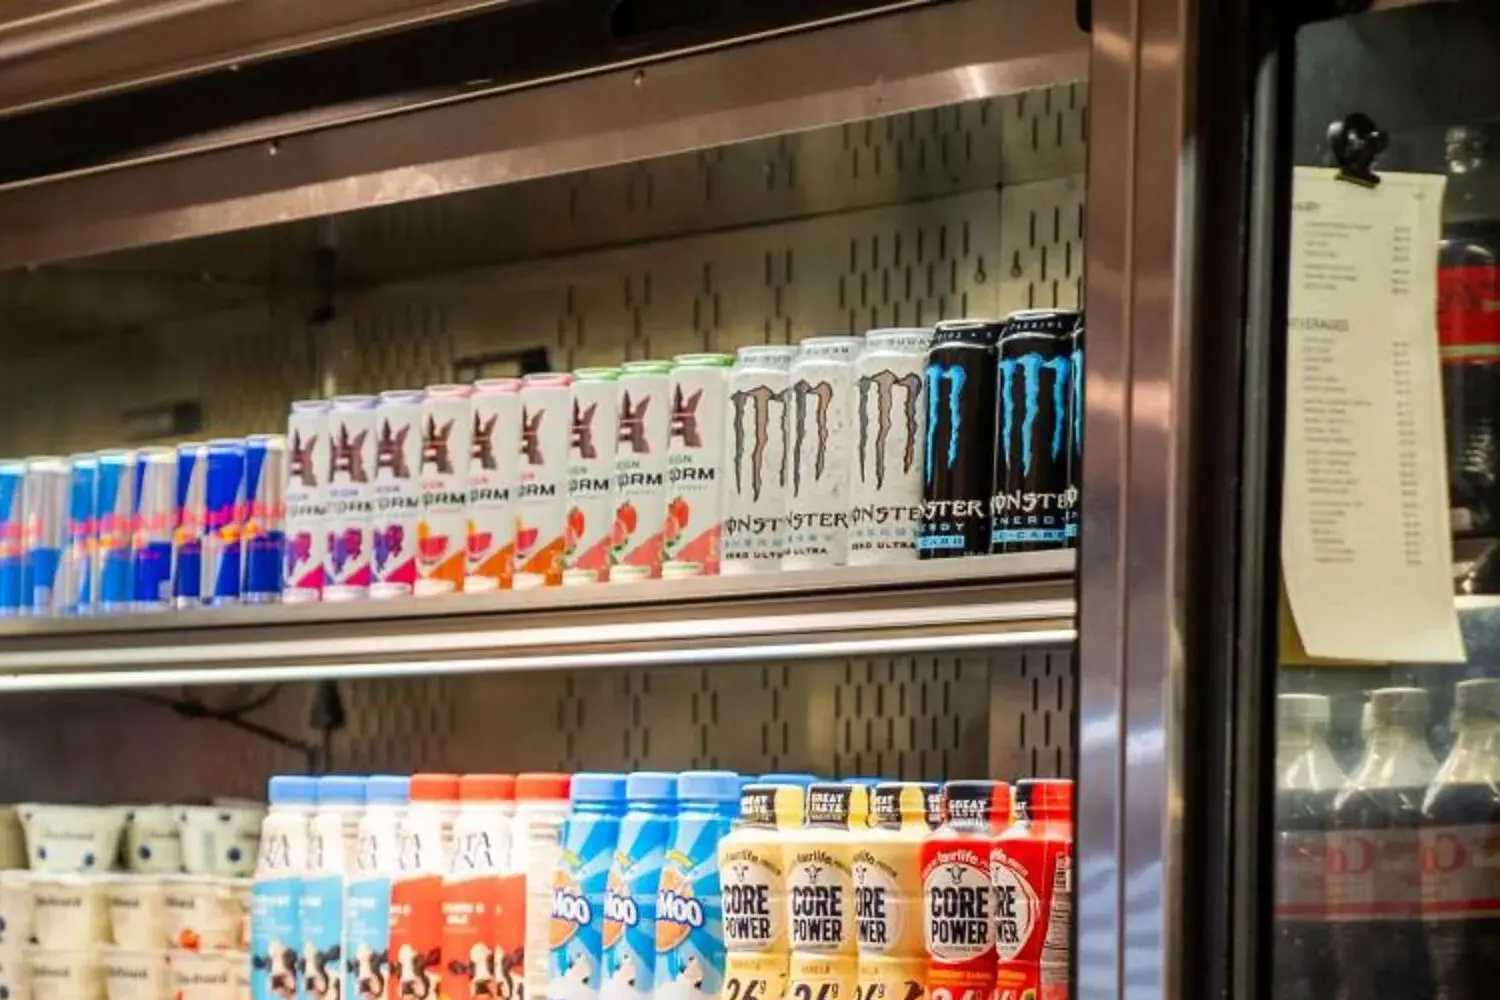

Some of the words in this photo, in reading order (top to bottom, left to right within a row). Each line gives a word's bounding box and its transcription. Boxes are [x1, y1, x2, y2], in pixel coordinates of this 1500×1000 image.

[723, 885, 770, 915] CORE
[792, 885, 843, 917] CORE
[931, 886, 989, 919] CORE
[725, 918, 771, 940] POWER
[793, 919, 843, 942] POWER
[932, 919, 988, 945] POWER
